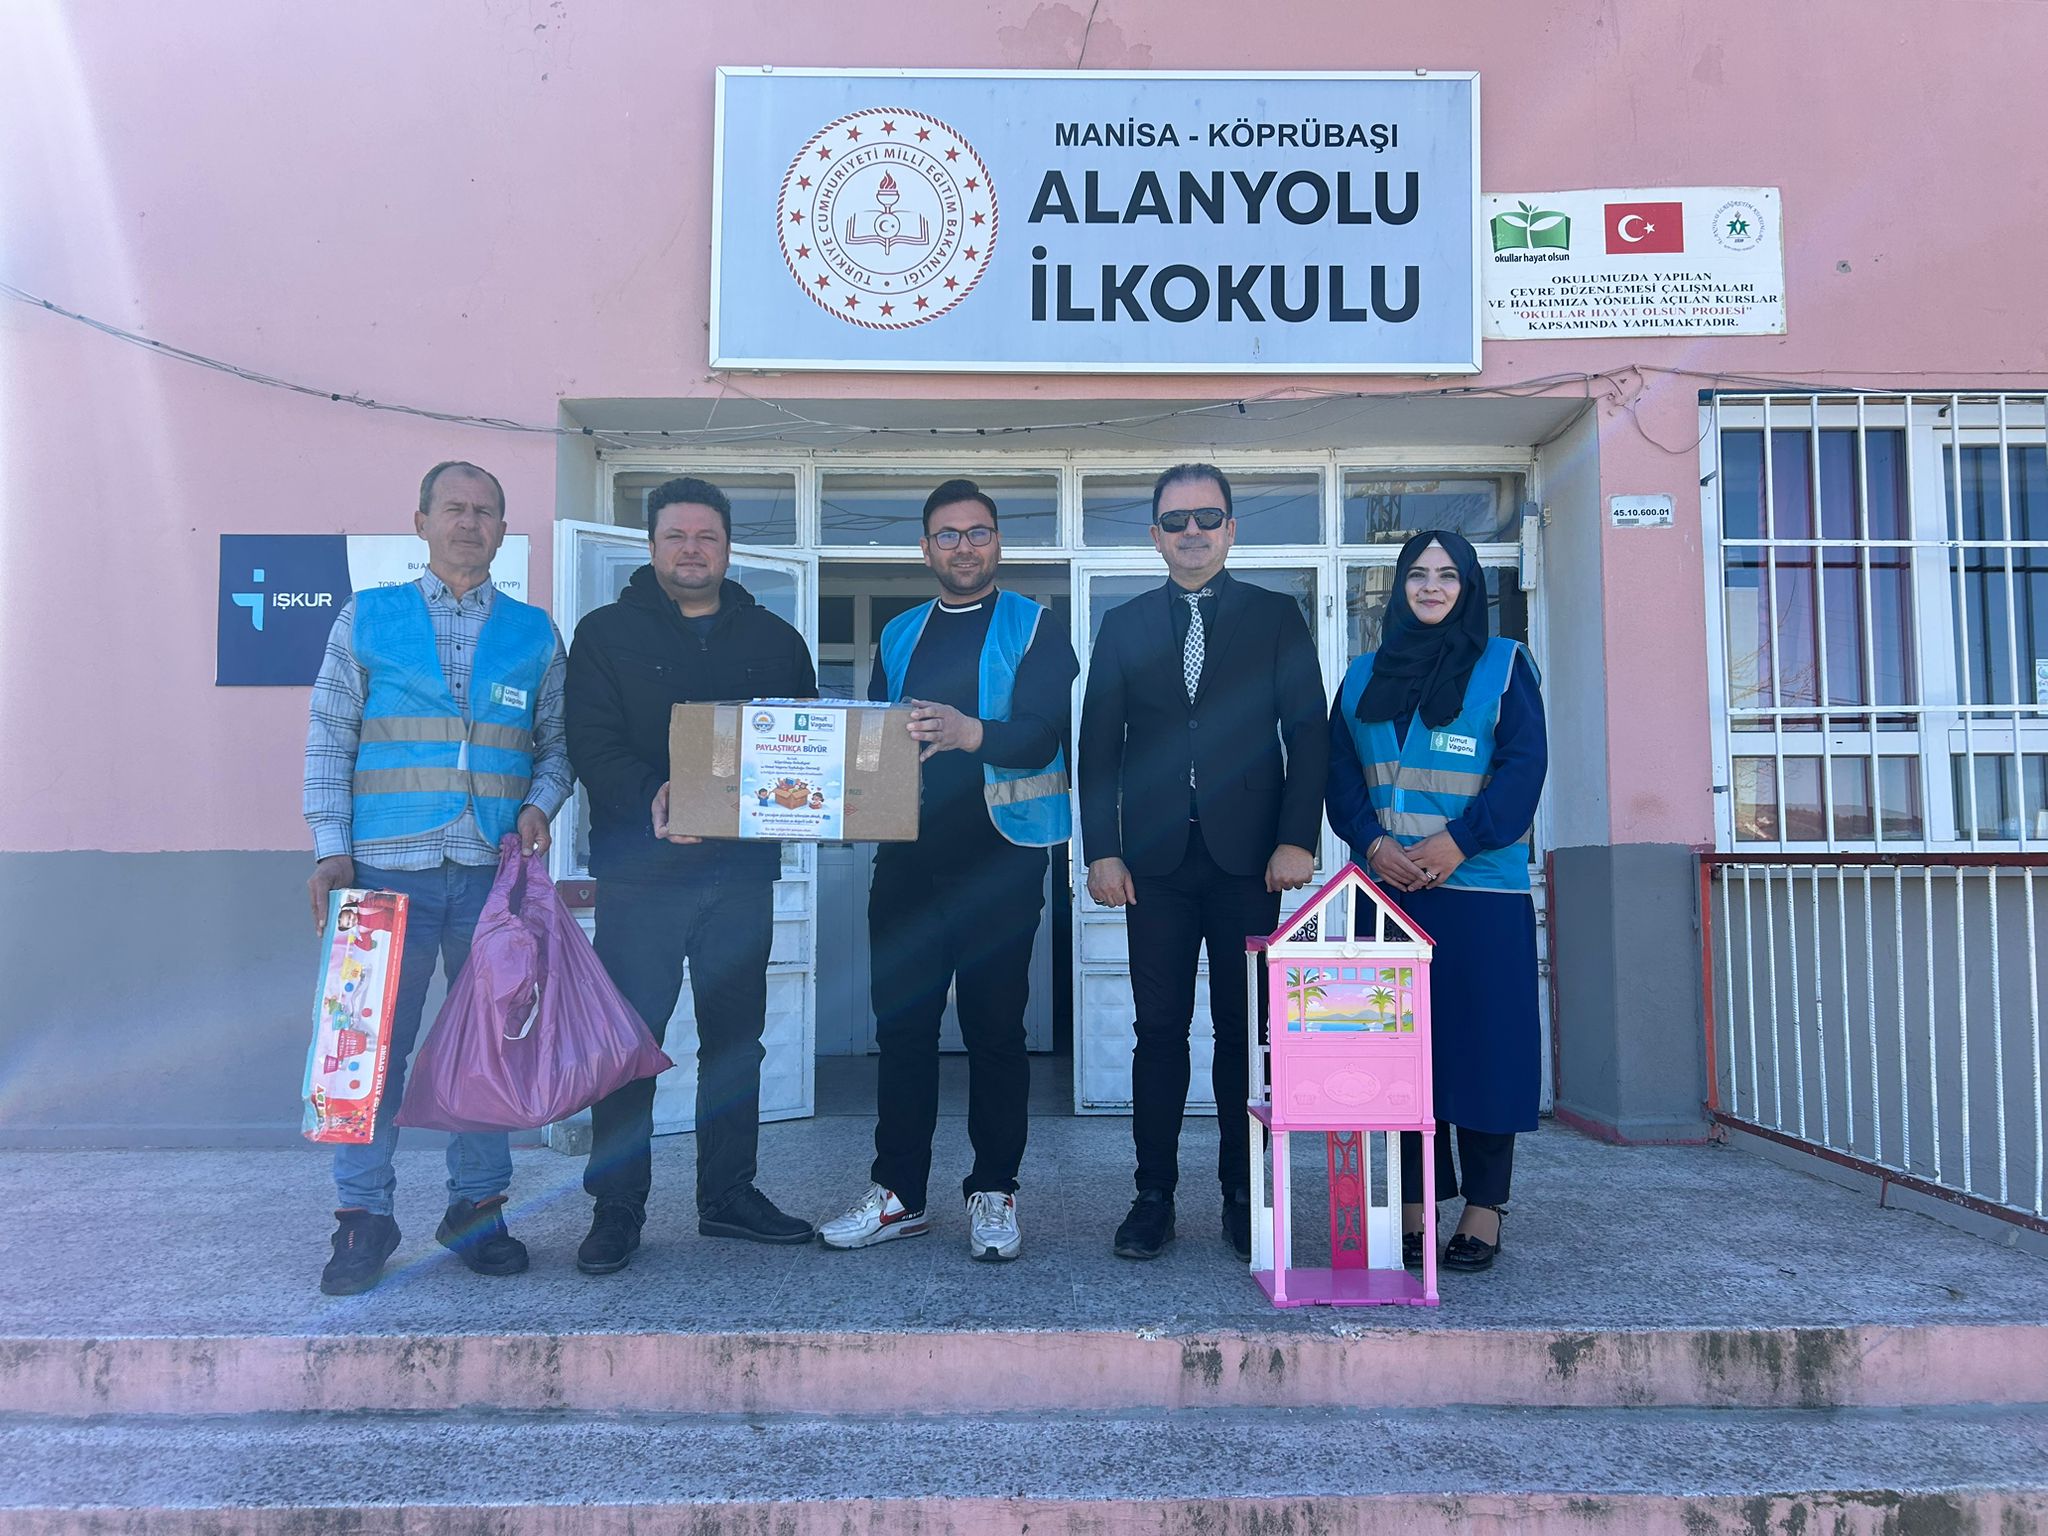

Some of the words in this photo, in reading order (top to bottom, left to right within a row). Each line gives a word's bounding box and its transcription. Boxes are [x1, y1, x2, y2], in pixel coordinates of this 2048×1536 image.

[1056, 117, 1180, 147] MANİSA
[1209, 117, 1398, 154] KÖPRÜBAŞI
[884, 147, 925, 167] MİLLİ
[818, 147, 878, 232] CUMHURİYETİ
[926, 164, 957, 213] EĞİTİM
[1027, 170, 1419, 226] ALANYOLU
[904, 219, 957, 286] BAKANLIĞI
[1494, 253, 1523, 263] okullar
[1523, 253, 1547, 264] hayat
[1547, 252, 1570, 262] olsun
[822, 237, 871, 286] TÜRKİYE
[1551, 273, 1649, 284] OKULUMUZDA
[1653, 272, 1712, 281] YAPILAN
[1031, 245, 1420, 324] İLKOKULU
[1510, 287, 1556, 298] ÇEVRE
[1560, 283, 1657, 296] DÜZENLEMESİ
[1661, 284, 1754, 294] ÇALIŞMALARI
[1488, 300, 1506, 309] VE
[1510, 298, 1589, 308] HALKIMIZA
[1593, 294, 1655, 306] YÖNELİK
[1660, 295, 1711, 305] AÇILAN
[1715, 294, 1778, 304] KURSLAR
[1513, 310, 1586, 319] "OKULLAR
[1591, 308, 1640, 317] HAYAT
[1643, 307, 1687, 316] OLSUN
[1528, 320, 1618, 330] KAPSAMINDA
[1622, 318, 1739, 328] YAPILMAKTADIR.
[1613, 508, 1670, 517] 45.10.600.01
[408, 562, 420, 570] BU
[499, 581, 521, 589] (TYP)
[811, 722, 833, 730] Vagonu
[778, 734, 807, 743] UMUT
[1449, 736, 1468, 744] Umut
[755, 744, 802, 754] PAYLAŞTIKÇA
[803, 744, 828, 753] BÜYÜR
[1449, 743, 1474, 752] Vagonu
